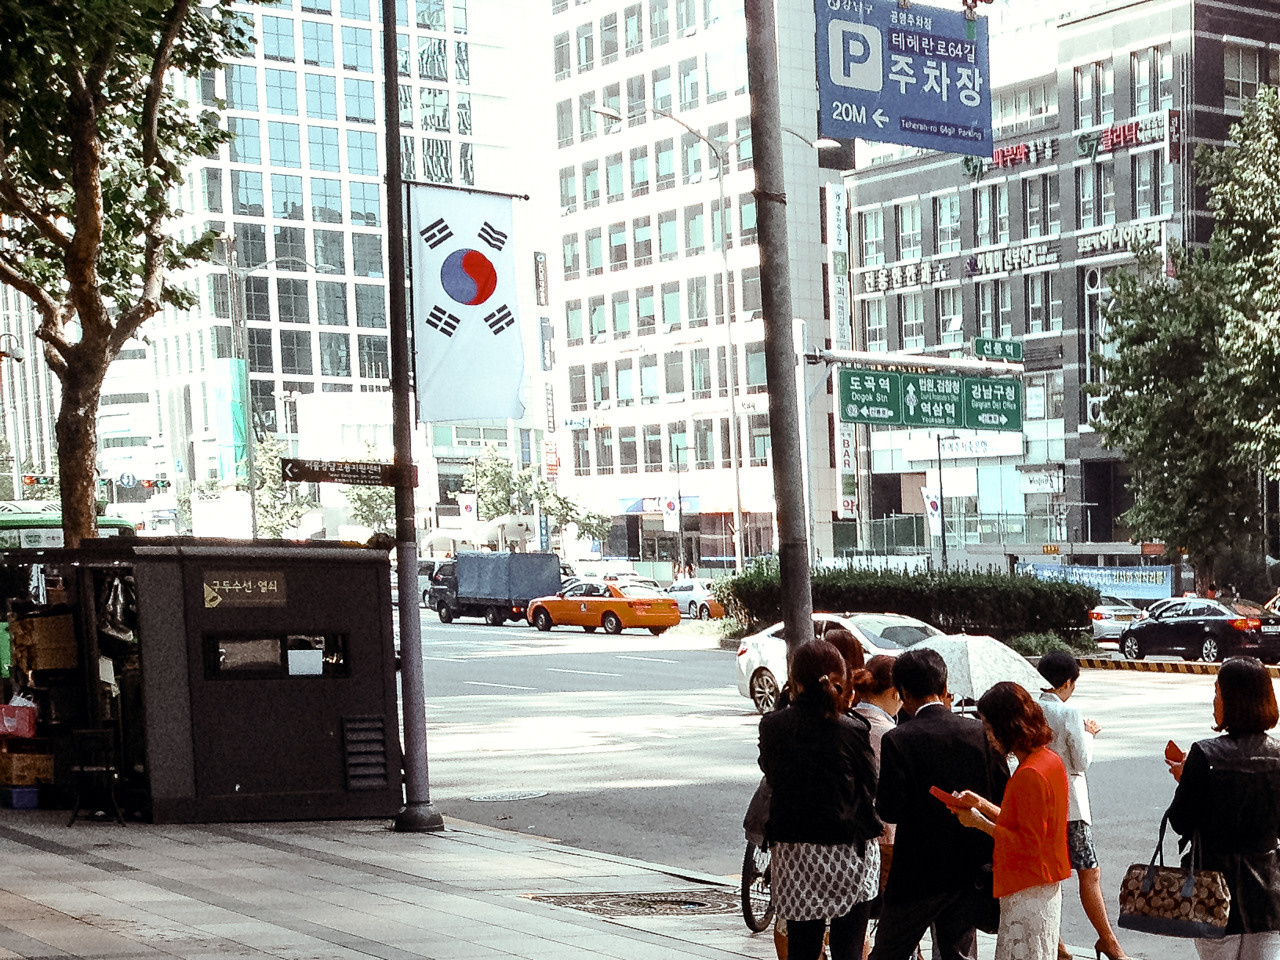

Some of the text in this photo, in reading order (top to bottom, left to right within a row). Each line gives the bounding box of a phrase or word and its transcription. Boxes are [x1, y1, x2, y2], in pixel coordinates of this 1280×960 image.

[890, 11, 932, 30] 공영주차장
[842, 30, 871, 78] P
[892, 33, 975, 63] 테헤란로64길
[888, 54, 983, 107] 주차장
[832, 101, 867, 124] 20M
[1101, 122, 1137, 150] 클리닉
[850, 376, 890, 393] 도곡역
[971, 384, 1015, 401] 강남구청
[851, 391, 874, 404] Dogok
[920, 401, 956, 418] 역삼역
[842, 439, 851, 469] BAR
[842, 500, 855, 515] 약
